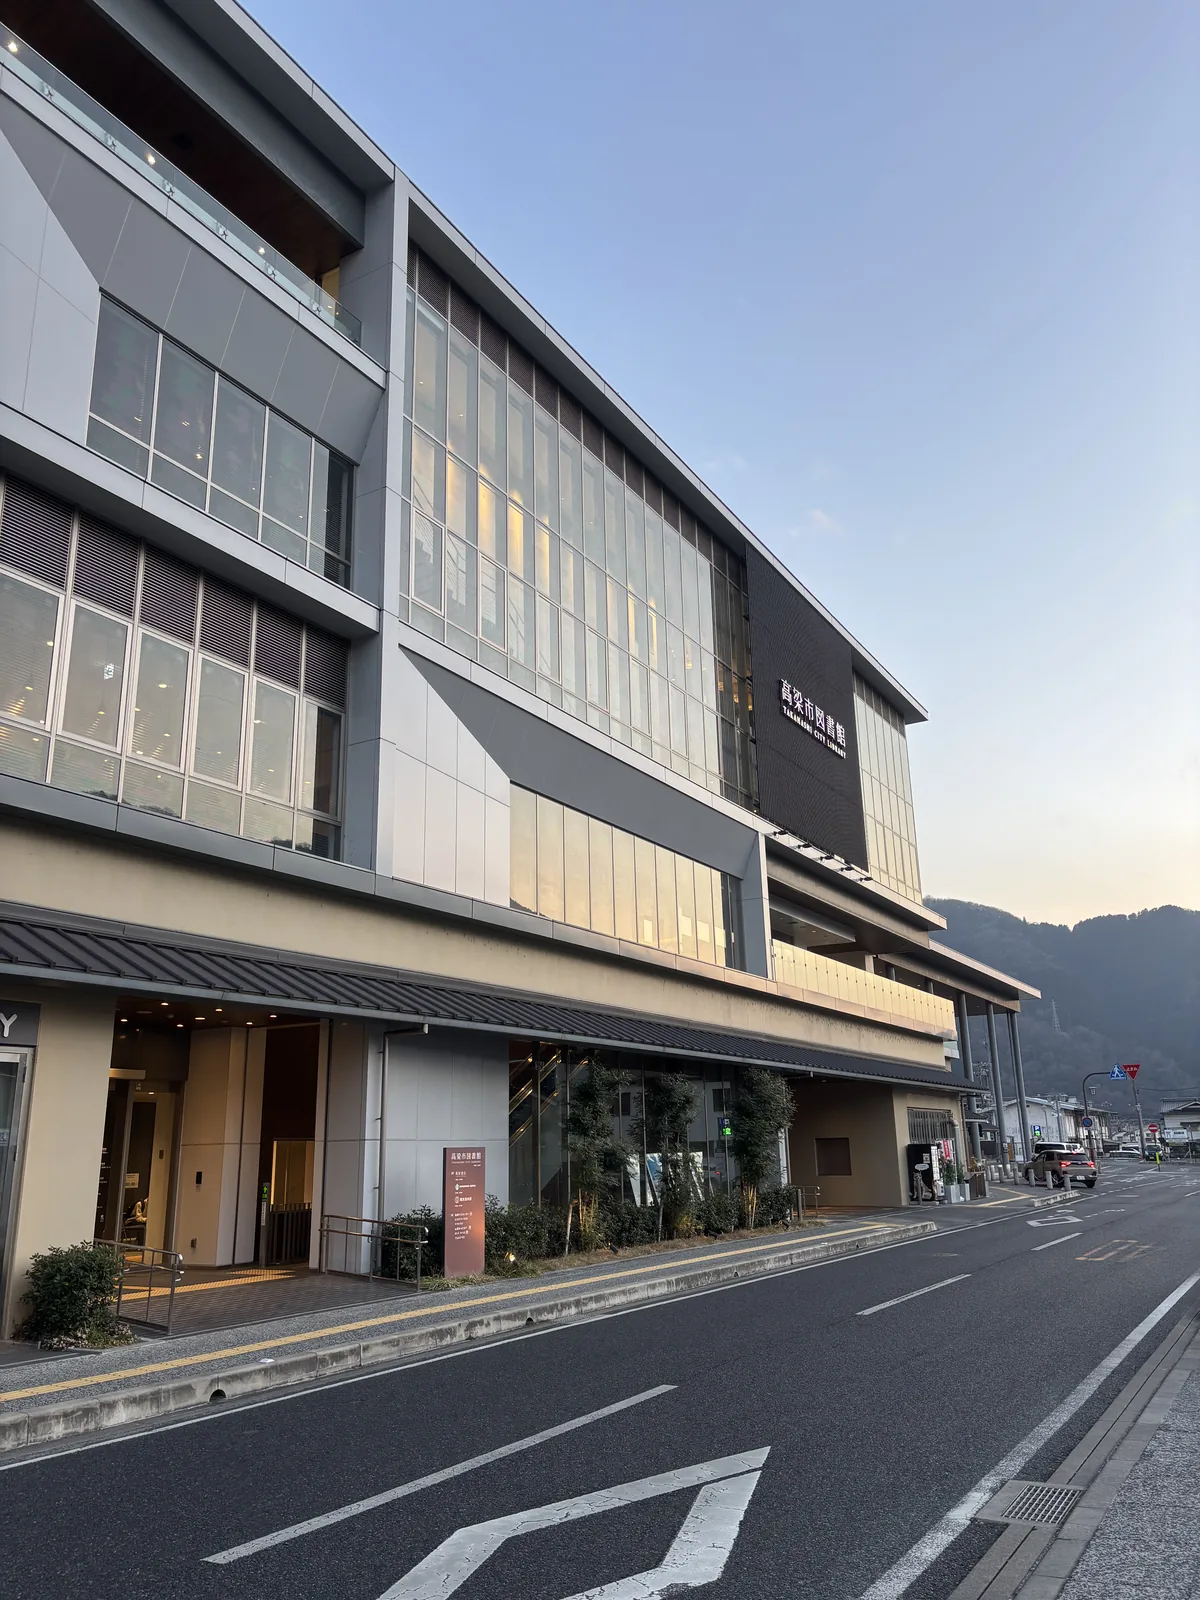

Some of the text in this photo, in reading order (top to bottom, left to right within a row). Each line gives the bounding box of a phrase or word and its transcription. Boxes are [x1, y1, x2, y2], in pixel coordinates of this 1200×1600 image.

[781, 678, 846, 748] 高梁市図書館
[814, 729, 826, 744] CITY
[827, 739, 846, 759] LIBRARY
[0, 1012, 18, 1038] Y
